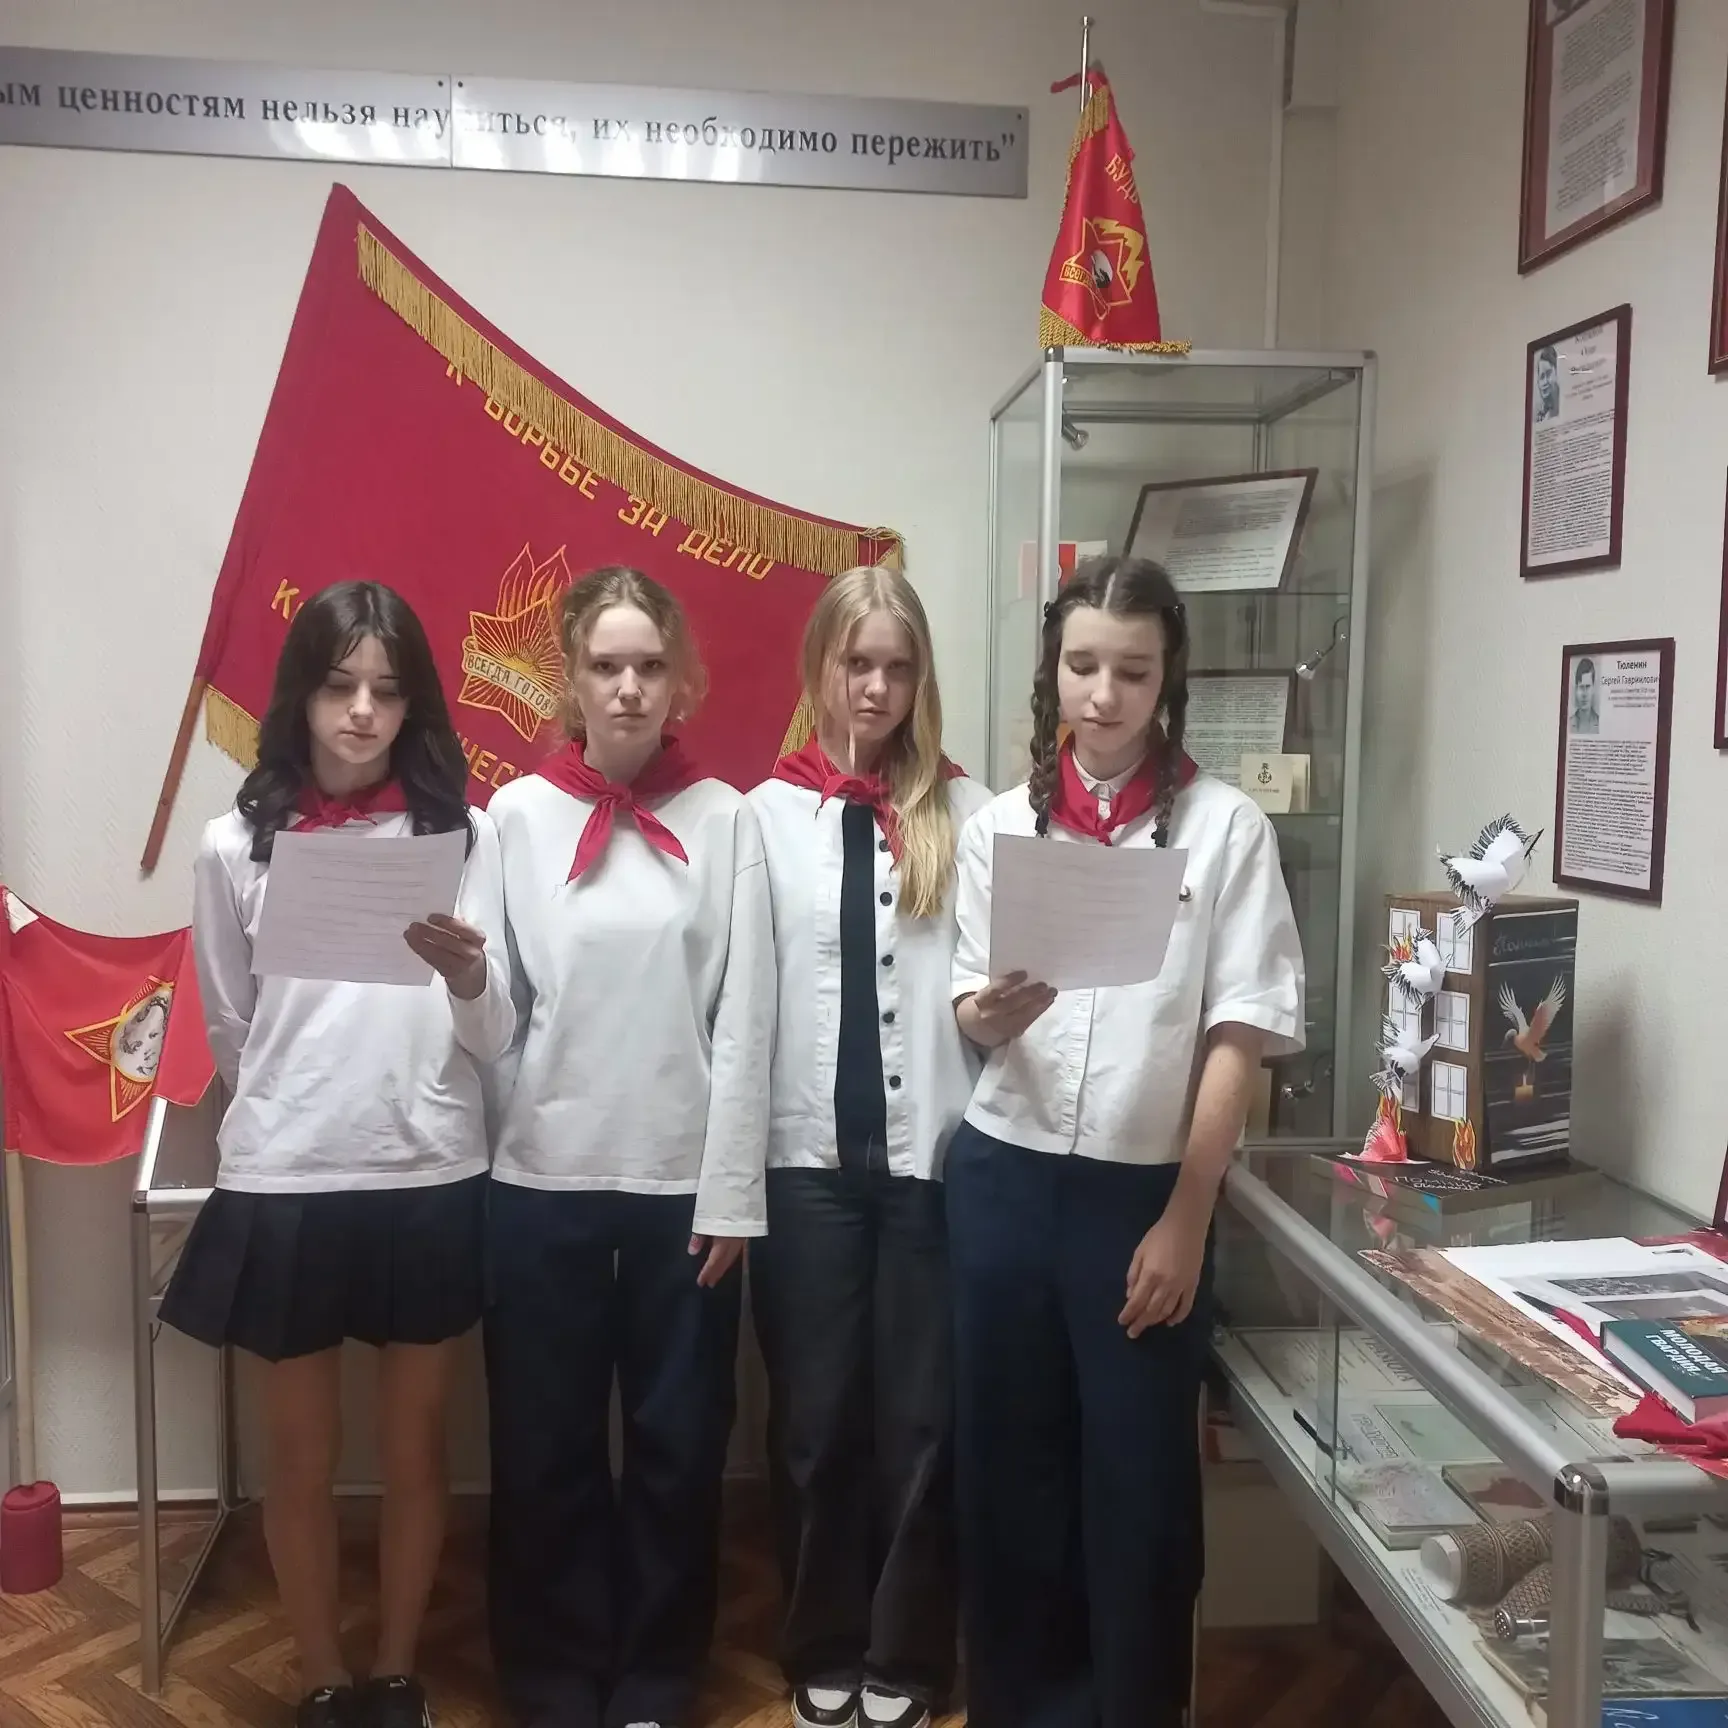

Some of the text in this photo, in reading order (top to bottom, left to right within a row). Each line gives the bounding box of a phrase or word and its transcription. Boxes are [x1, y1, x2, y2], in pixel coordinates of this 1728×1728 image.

[58, 86, 247, 119] ценностям
[262, 99, 377, 126] нельзя
[392, 104, 577, 144] науиться,
[593, 117, 631, 142] их
[645, 115, 838, 155] необходимо
[467, 654, 511, 685] ВСЕГДА
[1616, 660, 1648, 670] Тюленин
[1644, 1334, 1702, 1372] ГВАРДИЯ
[1659, 1328, 1728, 1374] МОЛОДАЯ
